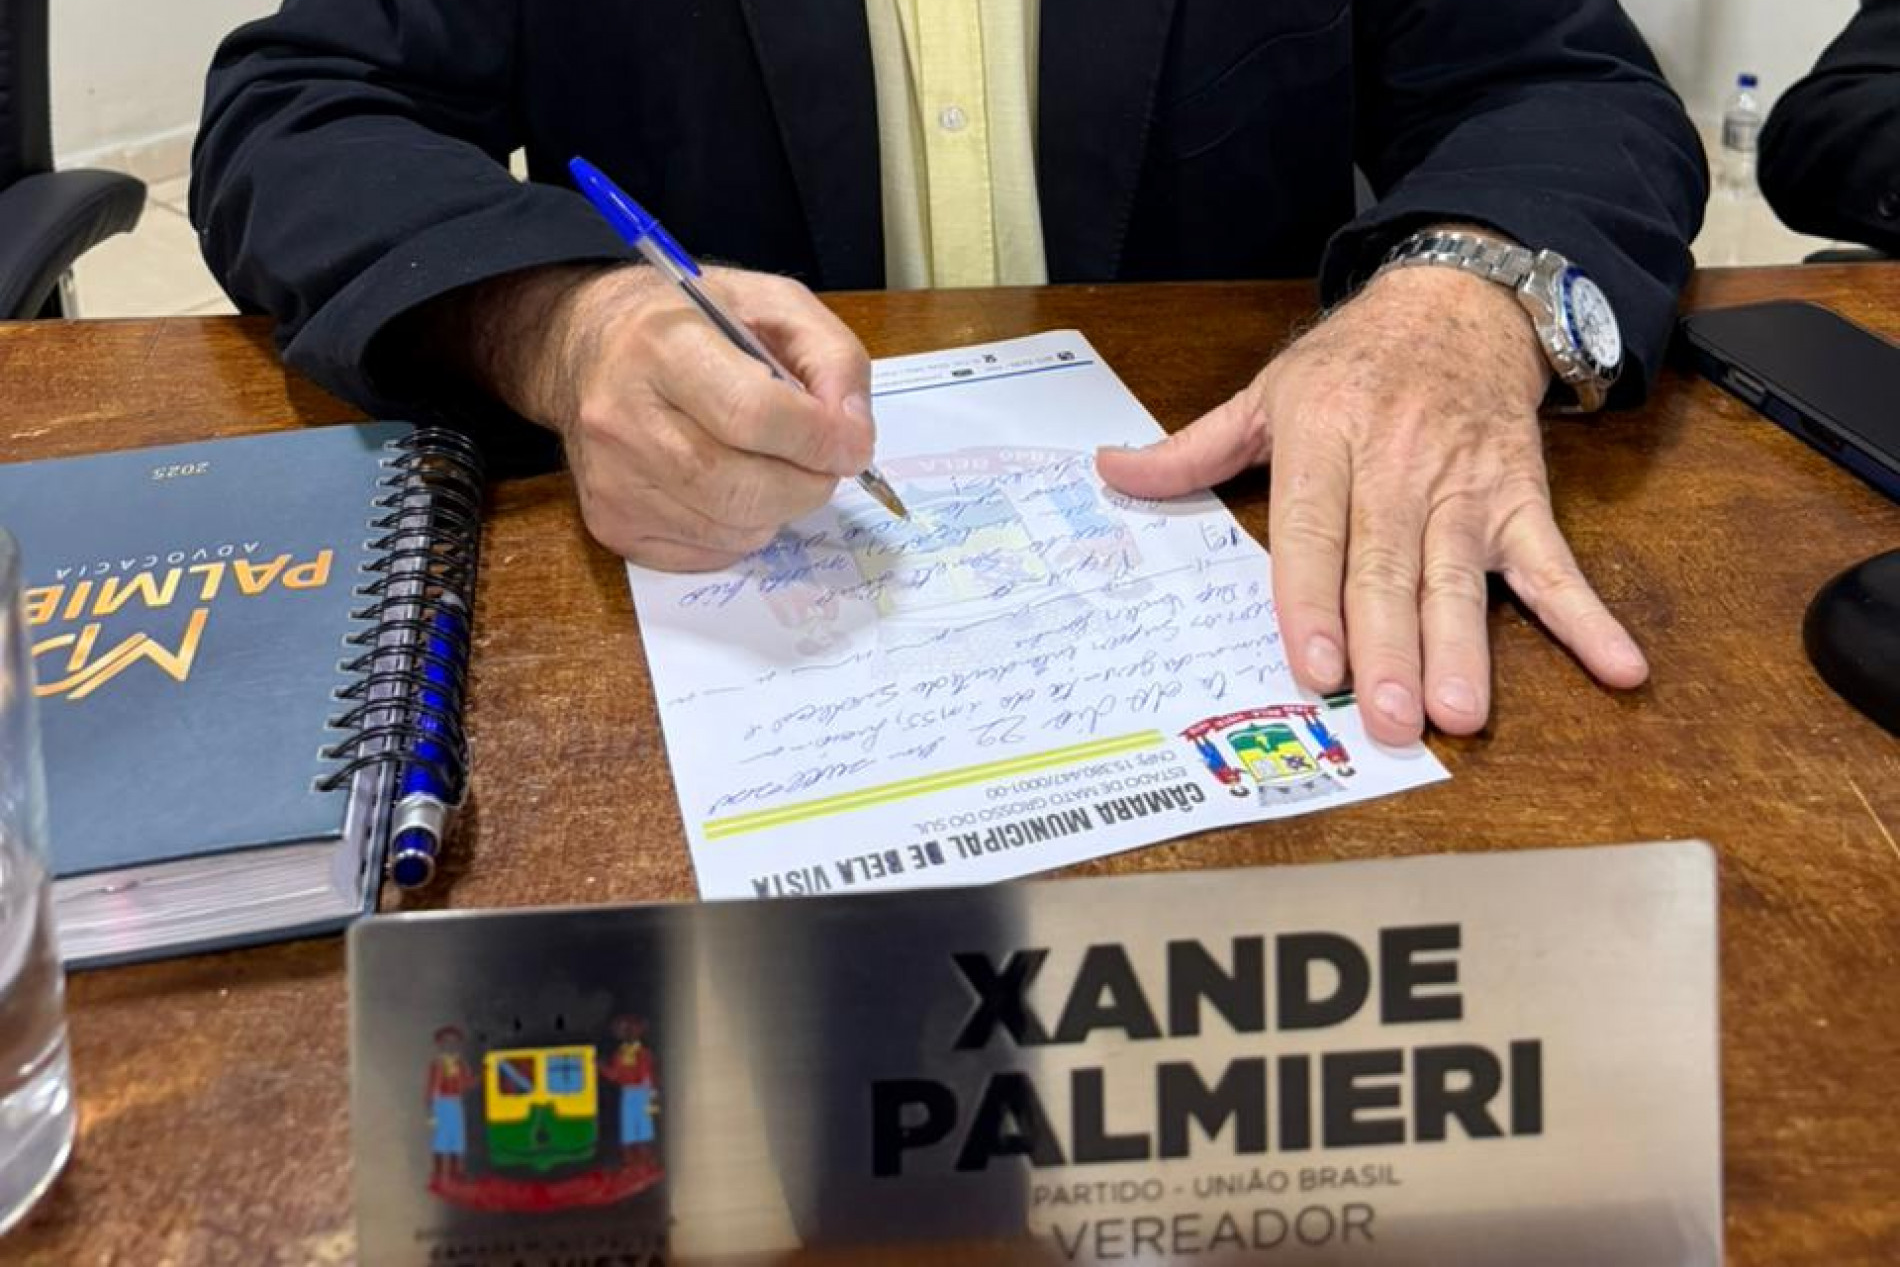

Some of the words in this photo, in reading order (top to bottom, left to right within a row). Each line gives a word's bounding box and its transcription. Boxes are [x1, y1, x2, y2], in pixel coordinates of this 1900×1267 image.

[151, 461, 210, 480] 2025
[56, 541, 260, 580] ADVOCACIA
[25, 548, 334, 626] PALMIE
[1048, 784, 1099, 805] MATO
[1100, 778, 1121, 795] DE
[1124, 766, 1187, 790] ESTADO
[949, 811, 976, 828] DO
[978, 796, 1047, 822] GROSSO
[1093, 781, 1206, 825] CÂMARA
[912, 817, 948, 835] SUL
[947, 807, 1093, 860] MUNICIPAL
[834, 848, 905, 886] BELA
[907, 840, 945, 870] DE
[750, 864, 832, 899] VISTA
[951, 922, 1464, 1051] XANDE
[870, 1038, 1543, 1178] PALMIERI
[1033, 1178, 1164, 1207] PARTIDO
[1193, 1167, 1290, 1200] UNIÃO
[1299, 1163, 1402, 1192] BRASIL
[1051, 1202, 1377, 1262] VEREADOR
